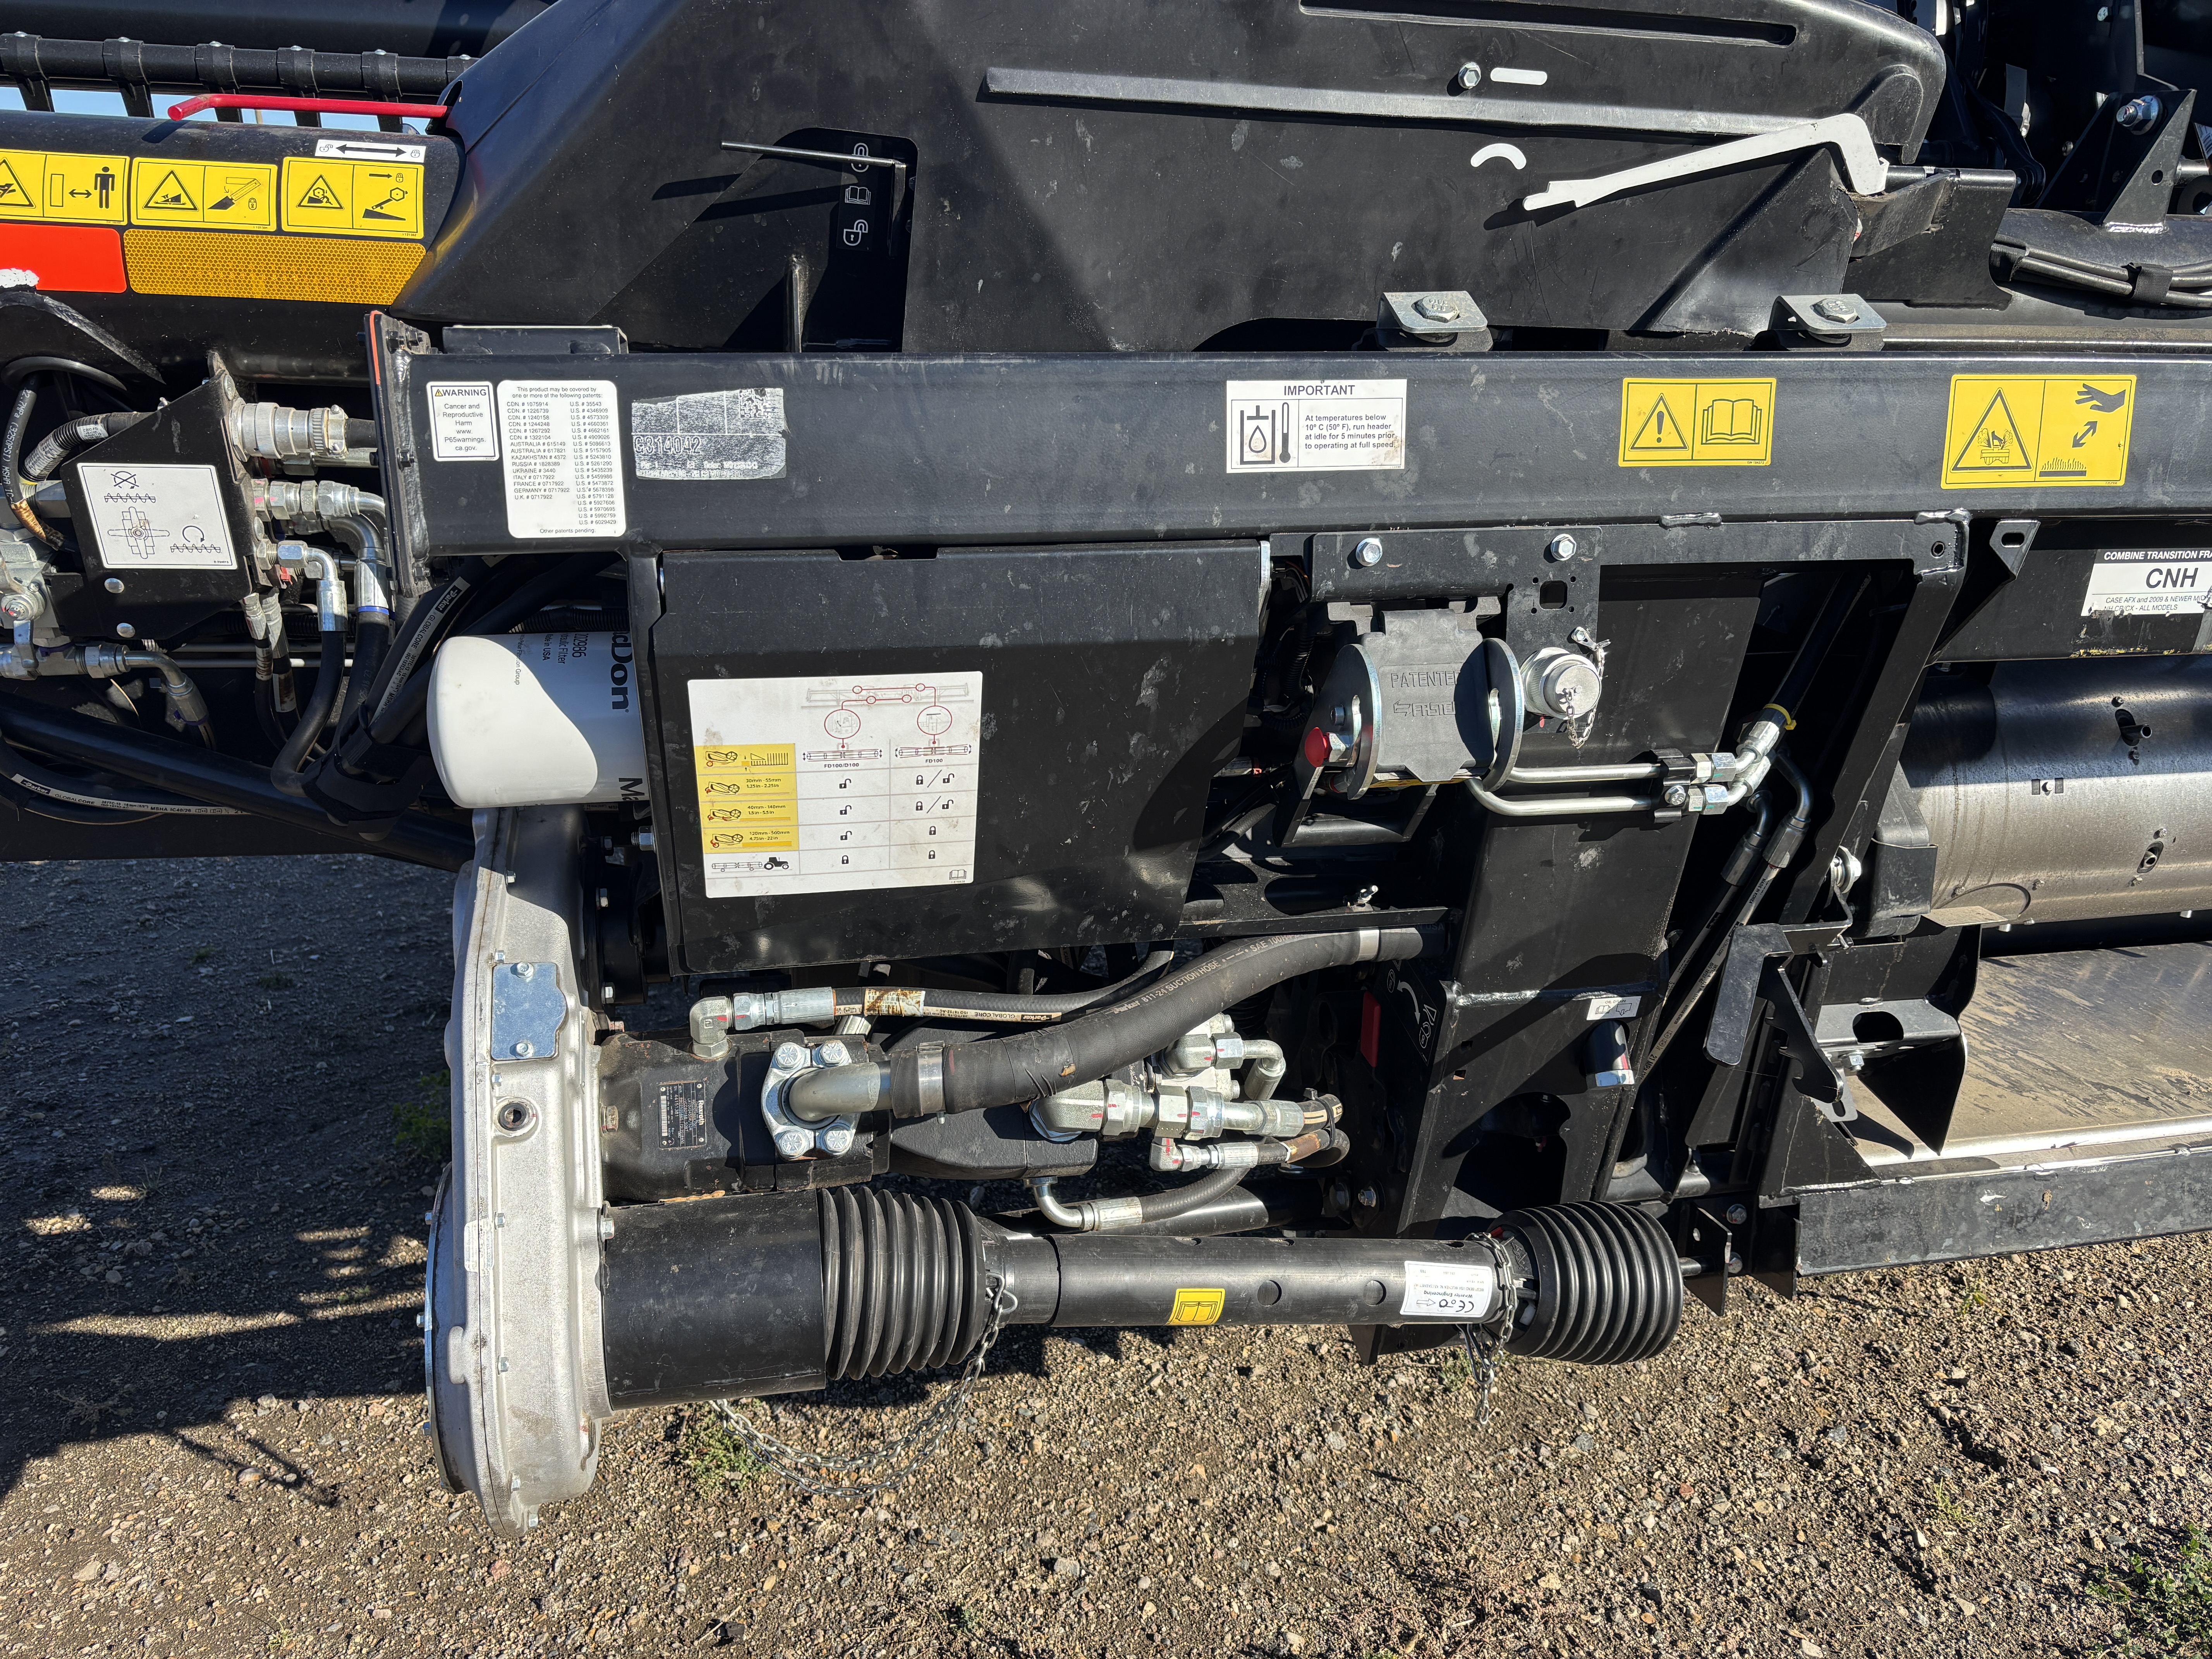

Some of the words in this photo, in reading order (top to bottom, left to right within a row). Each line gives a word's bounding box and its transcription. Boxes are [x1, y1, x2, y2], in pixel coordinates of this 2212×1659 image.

[1284, 385, 1355, 395] IMPORTANT
[3, 422, 19, 462] (3250PSI)
[2, 465, 12, 484] MSHA
[2104, 551, 2144, 560] COMBINE
[2147, 551, 2197, 559] TRANSITION
[2146, 568, 2198, 588] CNH
[438, 589, 458, 611] Parker
[542, 648, 550, 661] USA
[557, 648, 567, 664] Filter
[25, 782, 48, 794] Parker
[1250, 941, 1268, 952] SAE
[1141, 987, 1167, 1003] 811-24
[1165, 971, 1200, 991] SUCTION
[1199, 960, 1221, 974] HOSE
